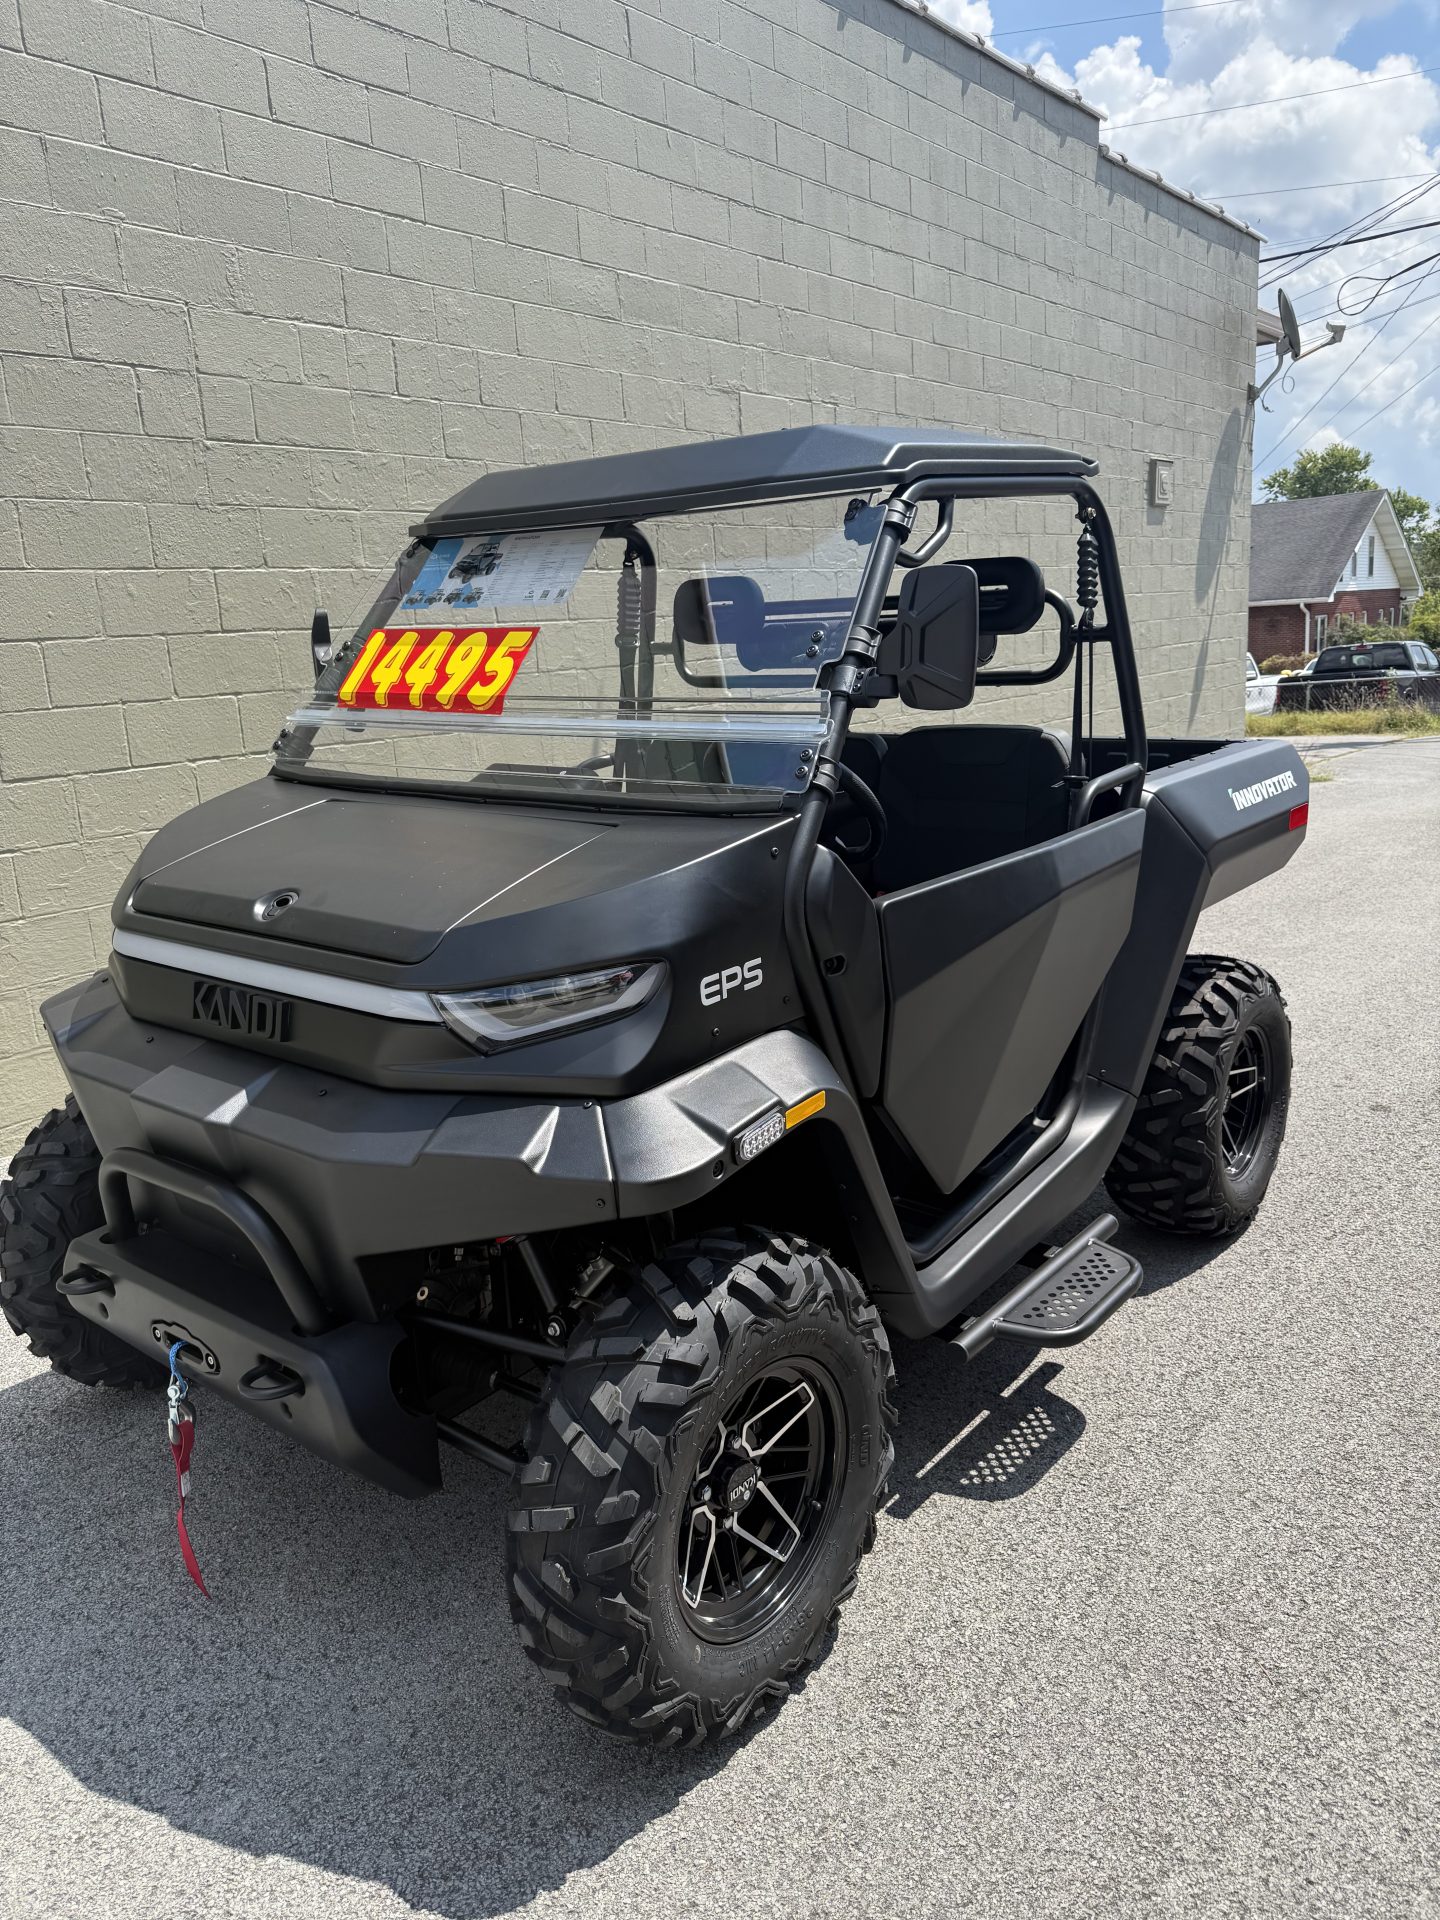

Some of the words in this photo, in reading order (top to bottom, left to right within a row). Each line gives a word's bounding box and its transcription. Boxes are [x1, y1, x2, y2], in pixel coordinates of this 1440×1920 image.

[339, 631, 532, 709] 14495
[1228, 770, 1297, 811] INNOVATOR
[700, 957, 763, 1006] EPS
[192, 981, 291, 1043] KANDI
[730, 1473, 756, 1502] KANDI
